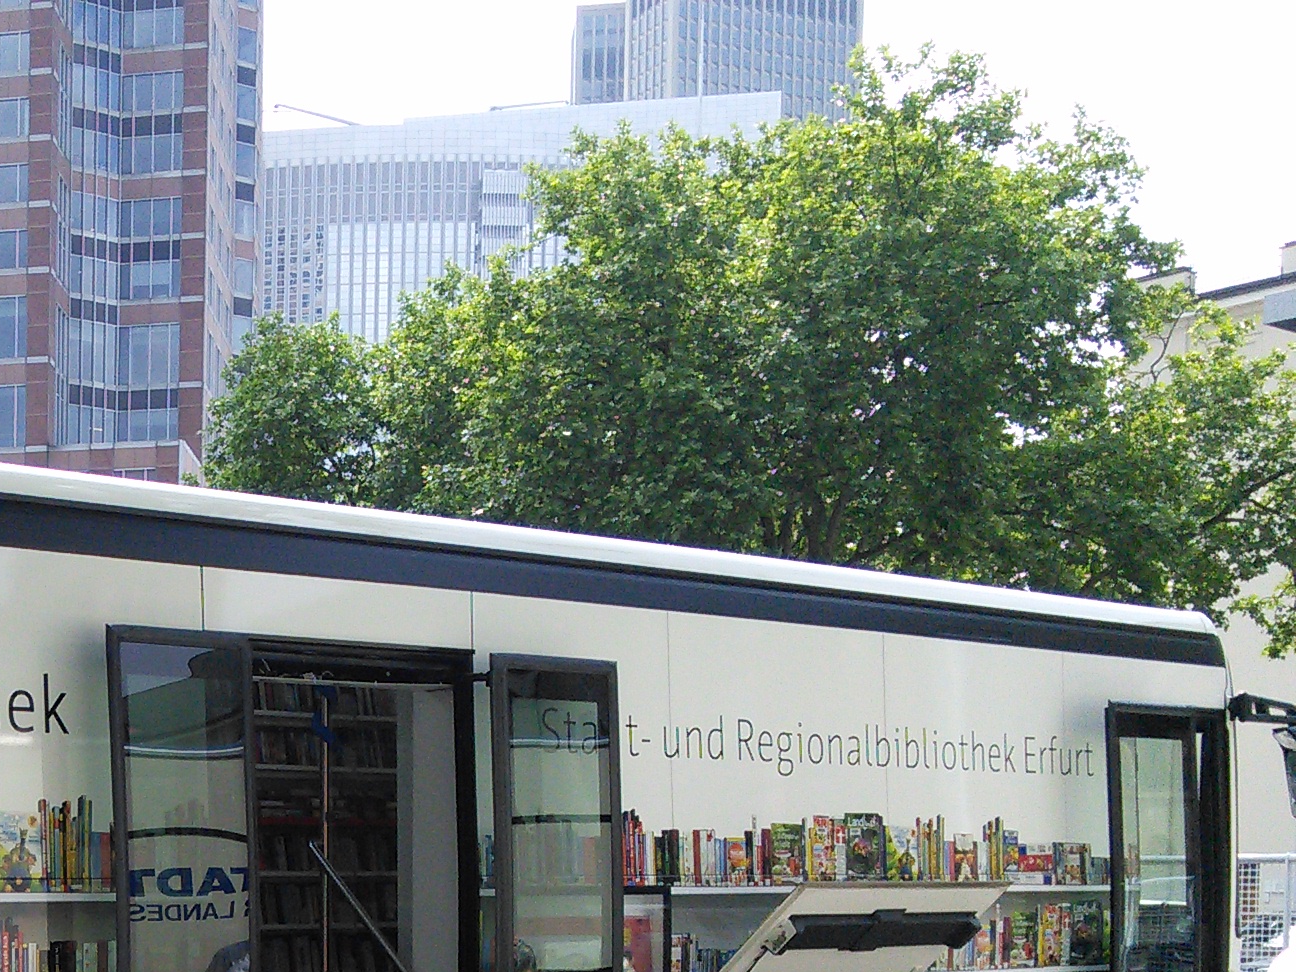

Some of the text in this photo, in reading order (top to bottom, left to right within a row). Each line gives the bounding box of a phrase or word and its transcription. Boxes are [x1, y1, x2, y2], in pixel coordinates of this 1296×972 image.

[541, 707, 1095, 777] Stat- und Regionalbibliothek Erfurt
